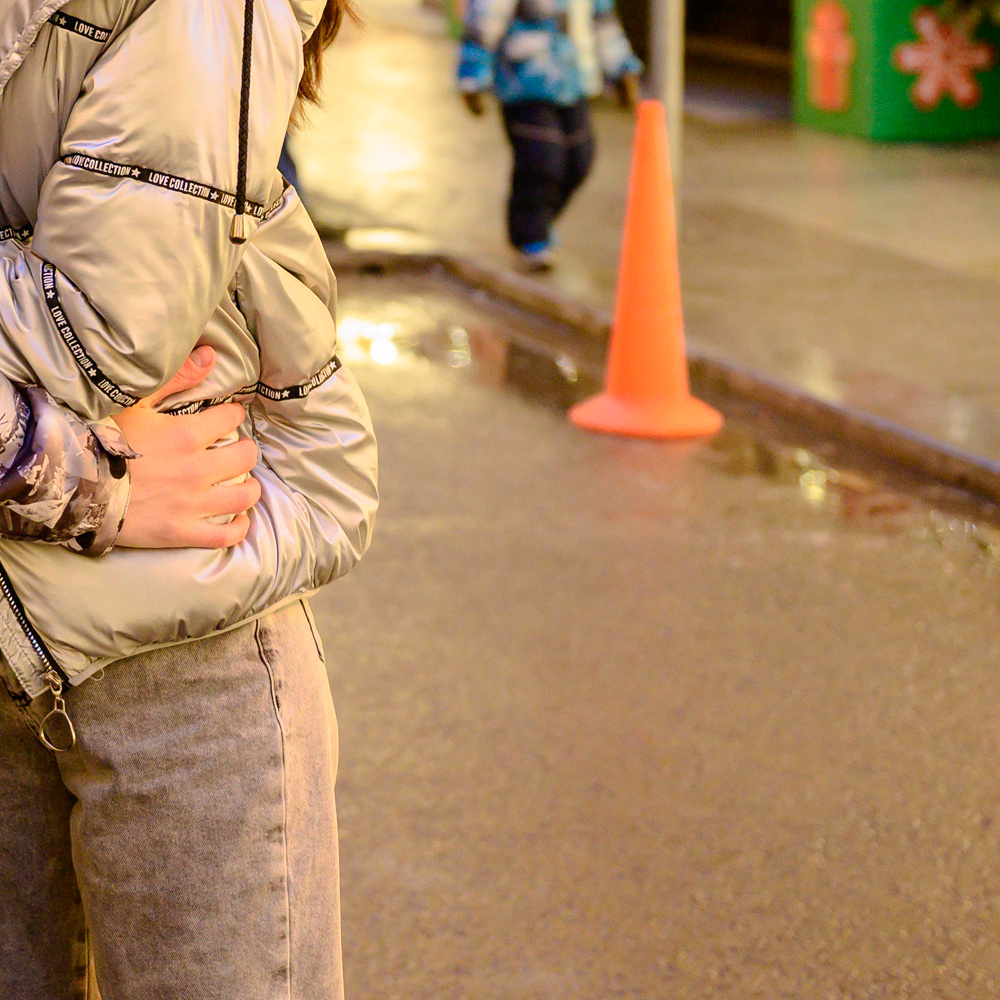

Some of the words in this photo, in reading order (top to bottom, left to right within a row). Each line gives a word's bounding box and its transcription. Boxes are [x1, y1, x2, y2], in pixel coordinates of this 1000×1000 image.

[74, 21, 95, 37] LOVE
[84, 158, 132, 176] COLLECTION
[148, 172, 169, 186] LOVE
[50, 306, 67, 327] LOVE
[60, 326, 93, 370] COLLECTION
[97, 379, 115, 394] LOVE
